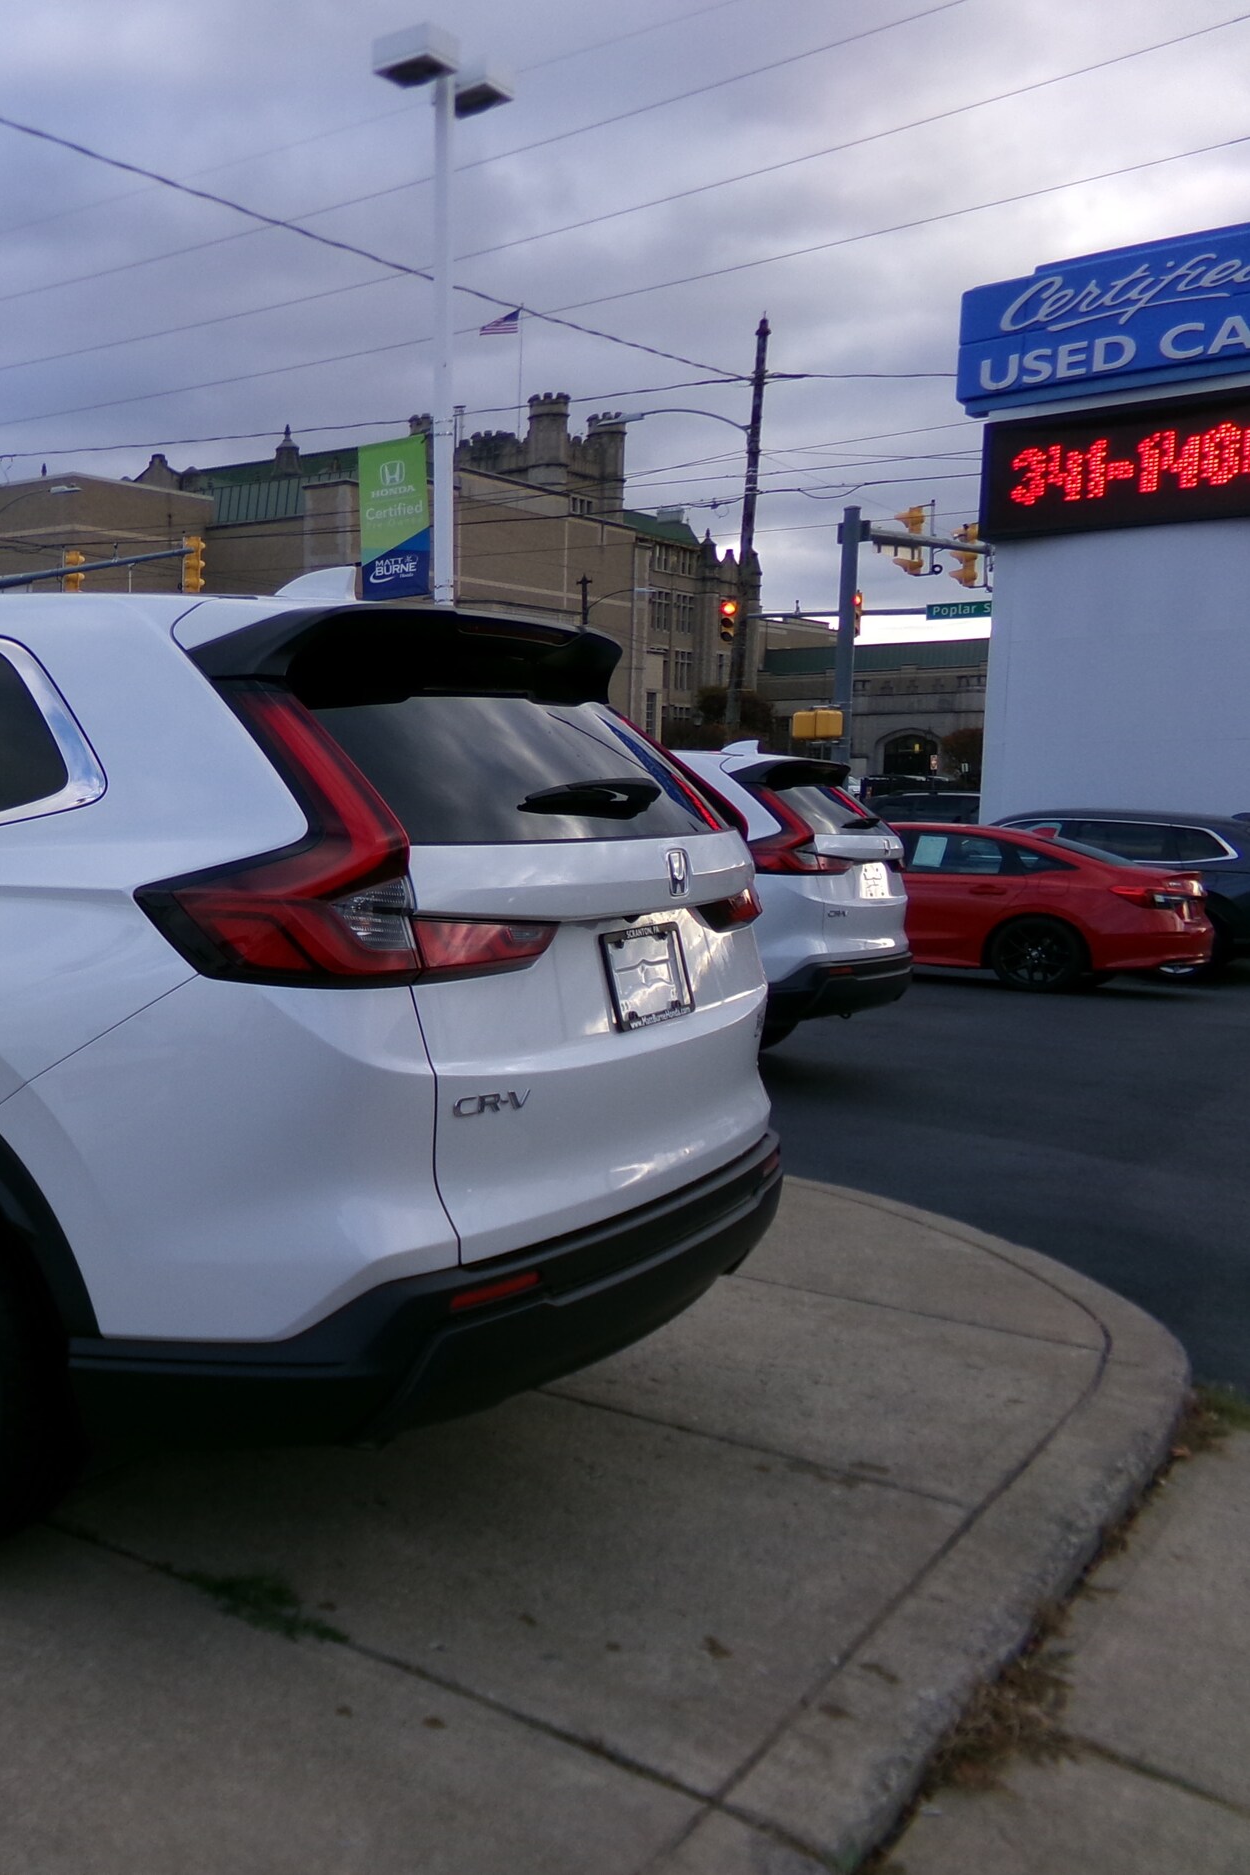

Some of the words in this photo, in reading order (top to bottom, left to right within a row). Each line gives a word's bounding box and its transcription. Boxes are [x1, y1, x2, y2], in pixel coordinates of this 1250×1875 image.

[979, 334, 1137, 391] USED
[370, 485, 416, 498] HONDA
[365, 499, 423, 520] Certified
[375, 557, 403, 567] MATT
[375, 562, 417, 576] BURNE
[932, 604, 978, 617] Poplar
[453, 1088, 531, 1117] CR-V
